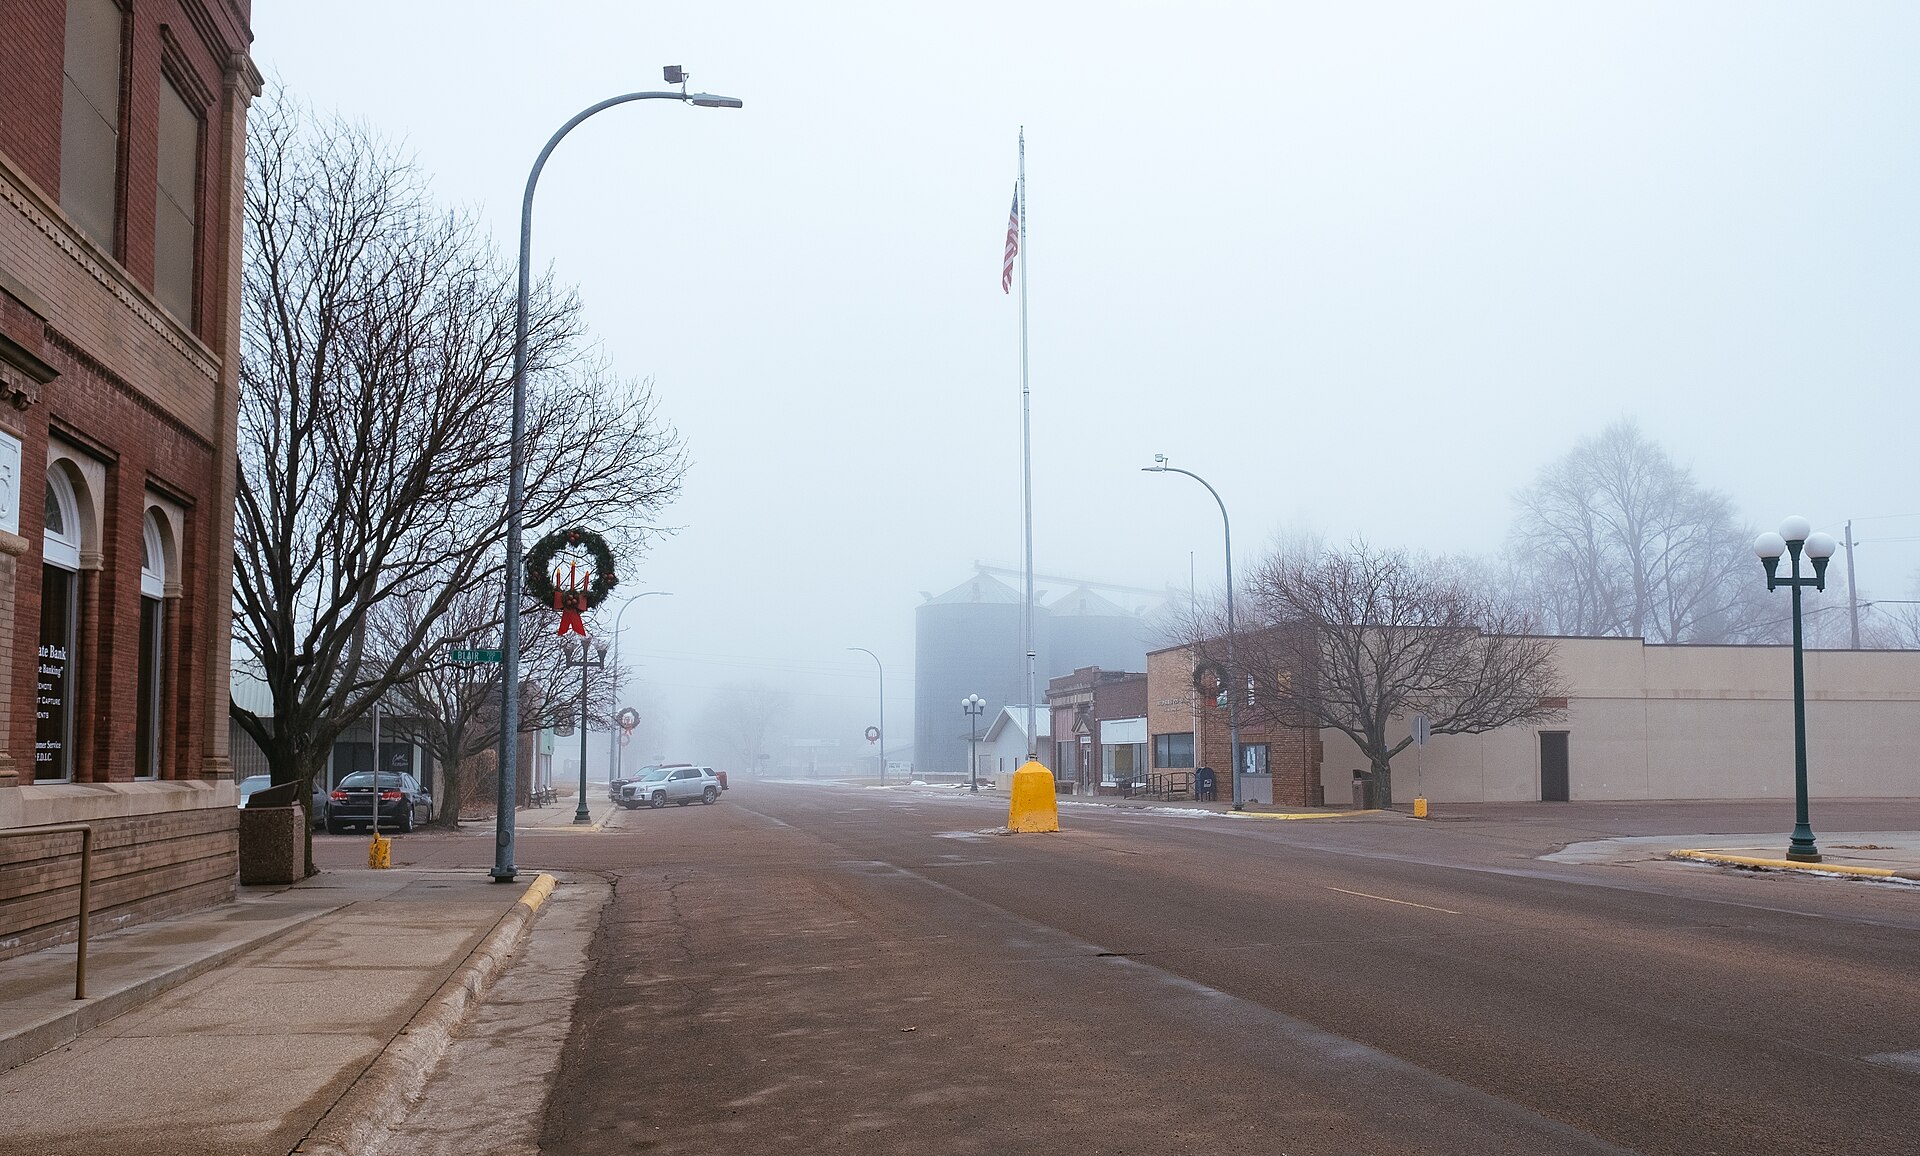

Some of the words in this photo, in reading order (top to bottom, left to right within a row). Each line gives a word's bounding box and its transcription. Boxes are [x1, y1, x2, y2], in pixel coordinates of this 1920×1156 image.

[38, 645, 49, 657] ate
[50, 645, 66, 660] Bank
[458, 651, 479, 660] BLAIR
